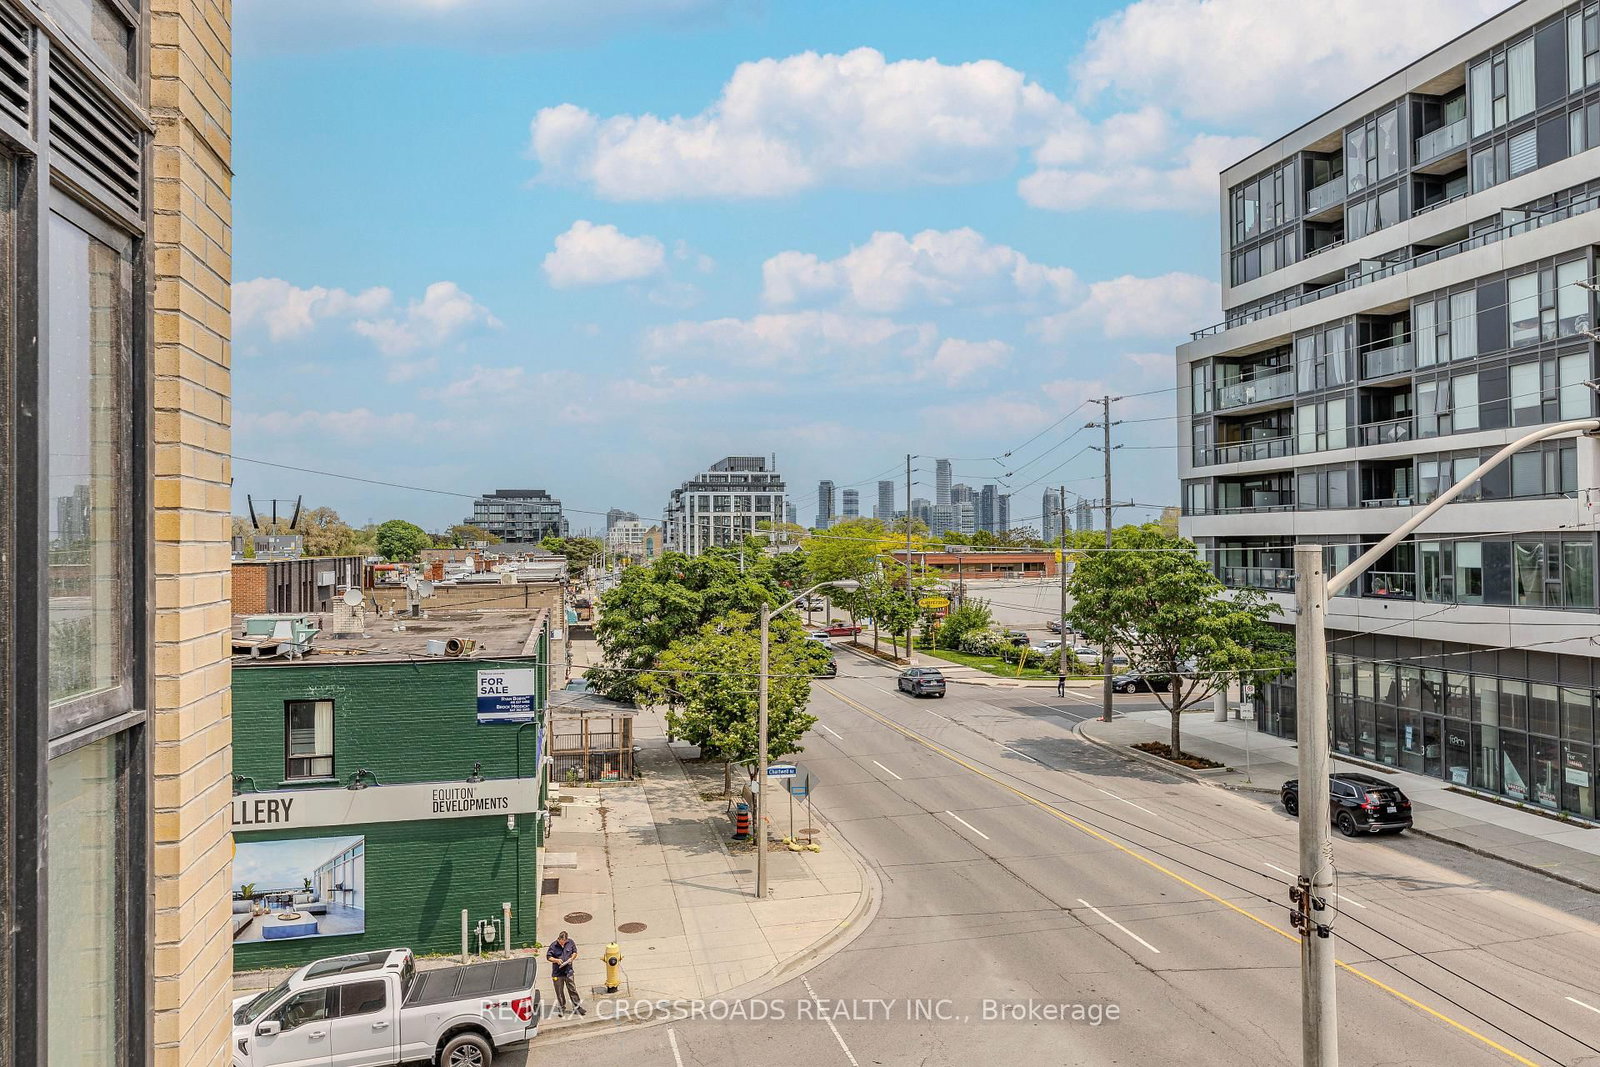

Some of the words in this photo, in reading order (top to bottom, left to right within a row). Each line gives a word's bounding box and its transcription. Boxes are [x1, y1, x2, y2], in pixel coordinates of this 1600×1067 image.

[481, 678, 503, 686] FOR
[481, 686, 508, 694] SALE
[432, 787, 475, 801] EQUITON
[432, 796, 509, 813] DEVELOPMENTS
